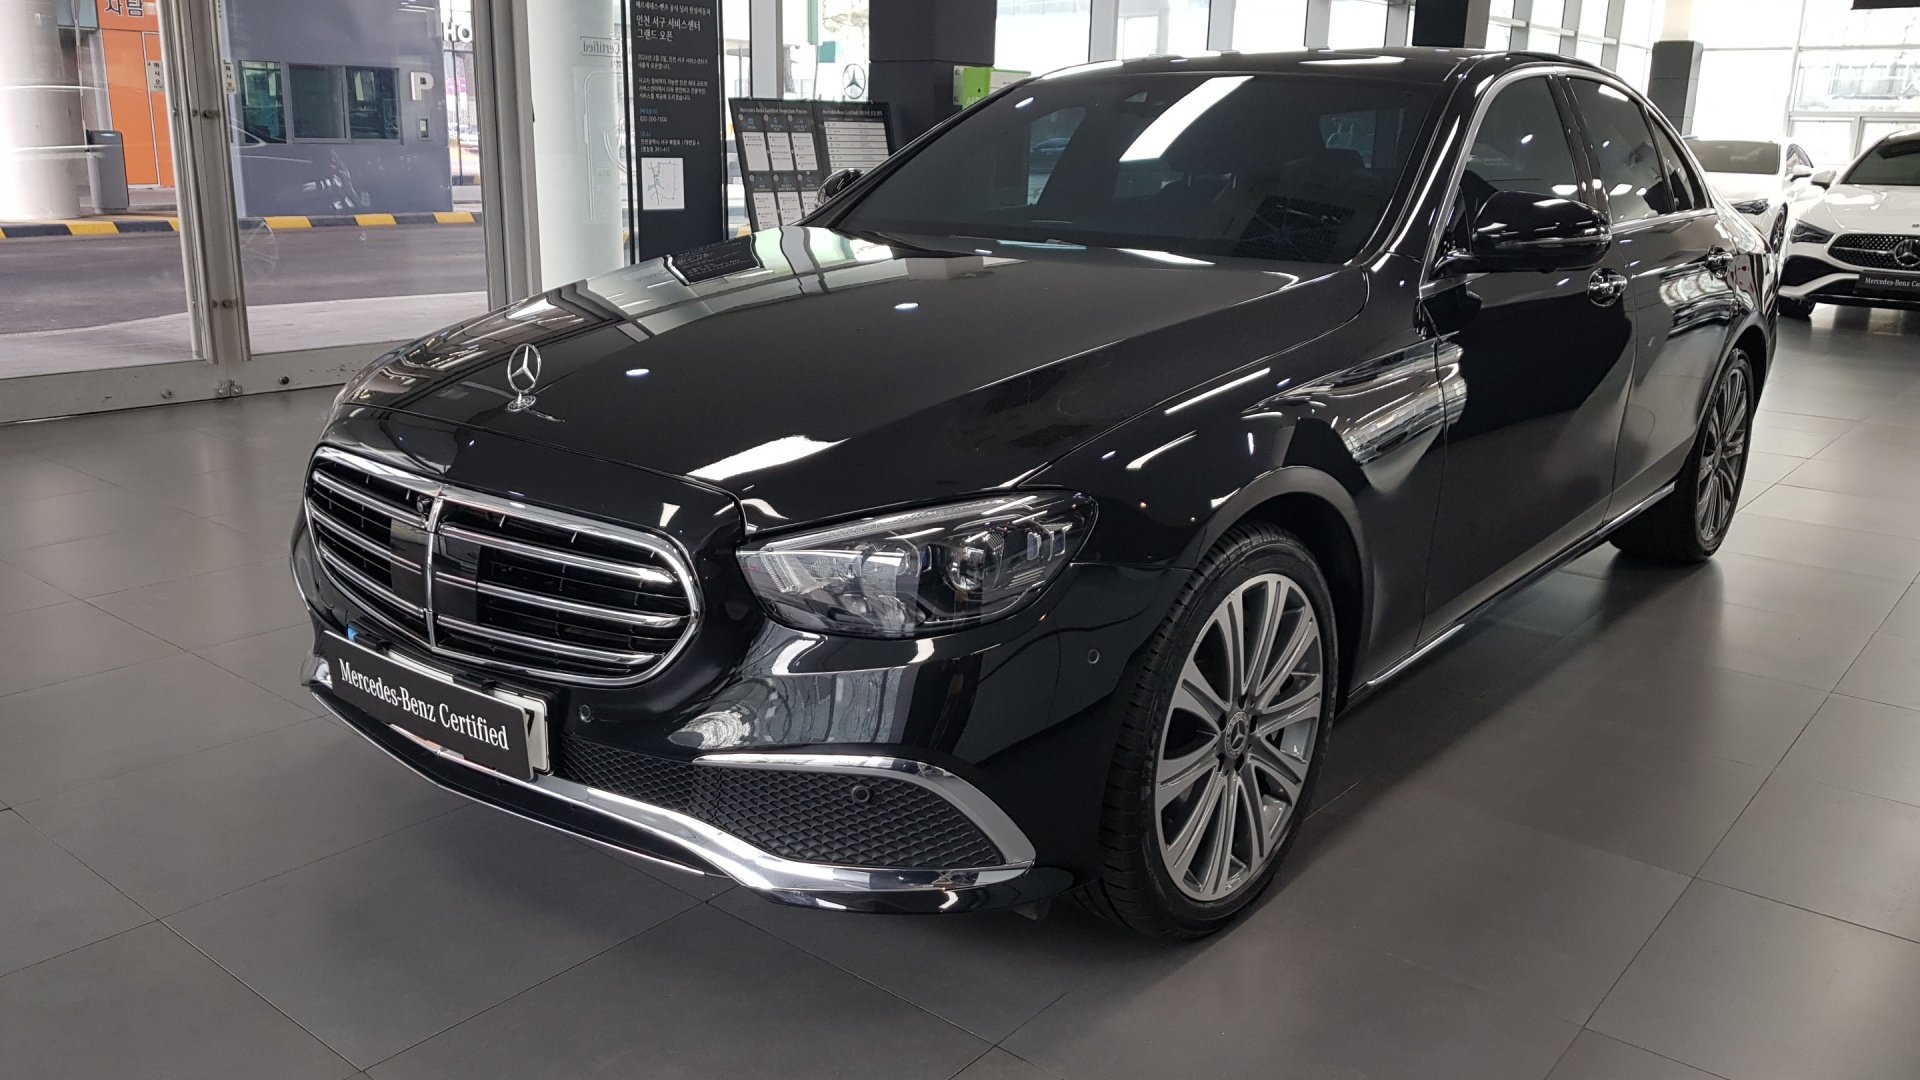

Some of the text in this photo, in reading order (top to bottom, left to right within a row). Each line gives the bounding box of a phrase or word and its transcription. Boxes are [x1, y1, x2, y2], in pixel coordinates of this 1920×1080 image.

[636, 14, 701, 32] 인천 서구 서비스센터
[636, 28, 674, 42] 그랜드 오픈
[410, 71, 434, 101] P
[1864, 277, 1910, 287] Mercedes-Benz
[338, 658, 510, 751] Mercedes-Benz Certified
